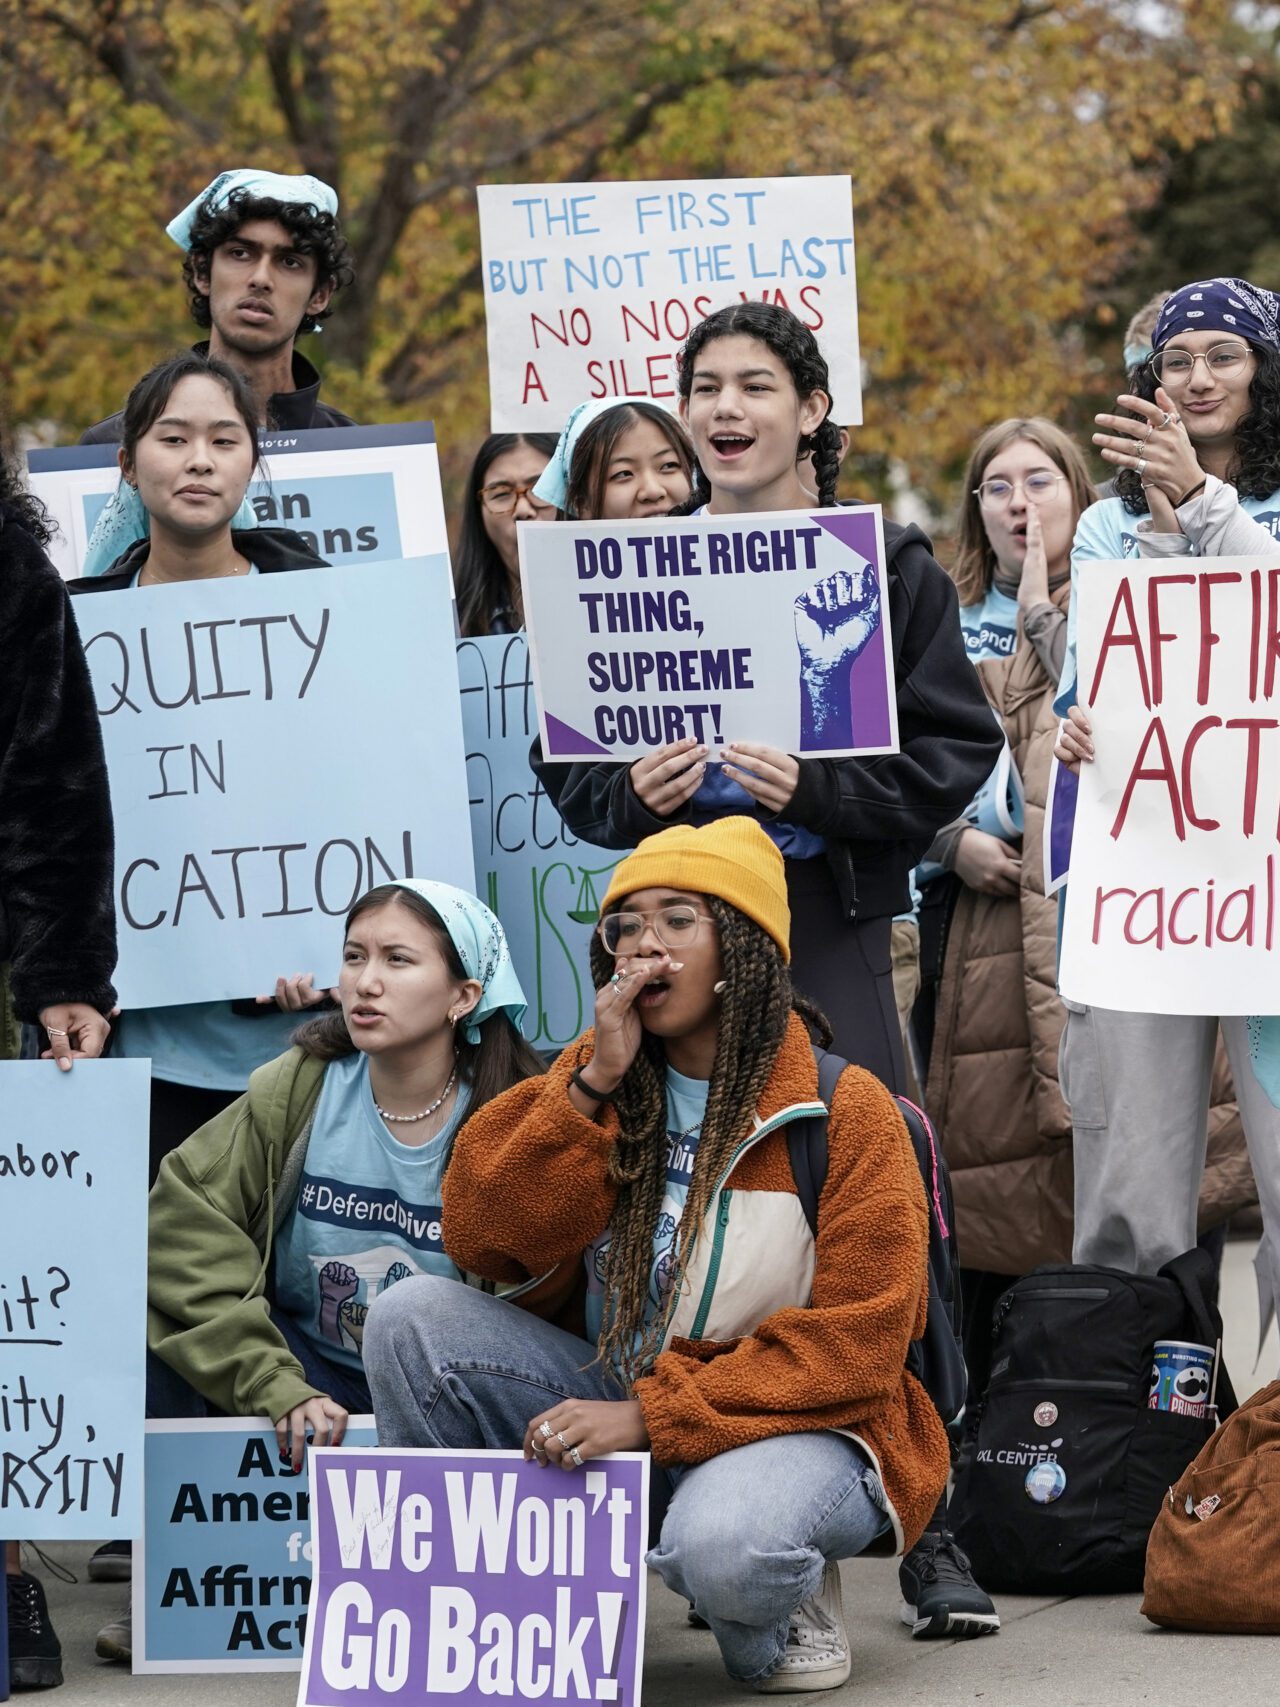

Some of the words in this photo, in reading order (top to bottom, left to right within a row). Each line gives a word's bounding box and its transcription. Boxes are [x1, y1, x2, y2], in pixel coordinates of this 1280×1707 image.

[513, 195, 600, 238] THE
[636, 191, 766, 234] FIRST
[488, 258, 547, 295] BUT
[565, 251, 650, 293] NOT
[668, 244, 736, 284] THE
[748, 237, 853, 280] LAST
[530, 307, 592, 349] NO
[522, 361, 549, 404] A
[587, 352, 685, 399] SILE
[575, 538, 623, 580] DO
[627, 534, 702, 578] THE
[707, 527, 822, 577] RIGHT
[579, 589, 704, 639] THING,
[587, 647, 754, 693] SUPREME
[594, 703, 724, 746] COURT!
[146, 739, 227, 800] IN
[1091, 853, 1275, 951] racial
[302, 1183, 444, 1242] #DefendDive
[325, 1468, 433, 1574] We
[321, 1580, 412, 1694] Go
[426, 1585, 625, 1700] Back!
